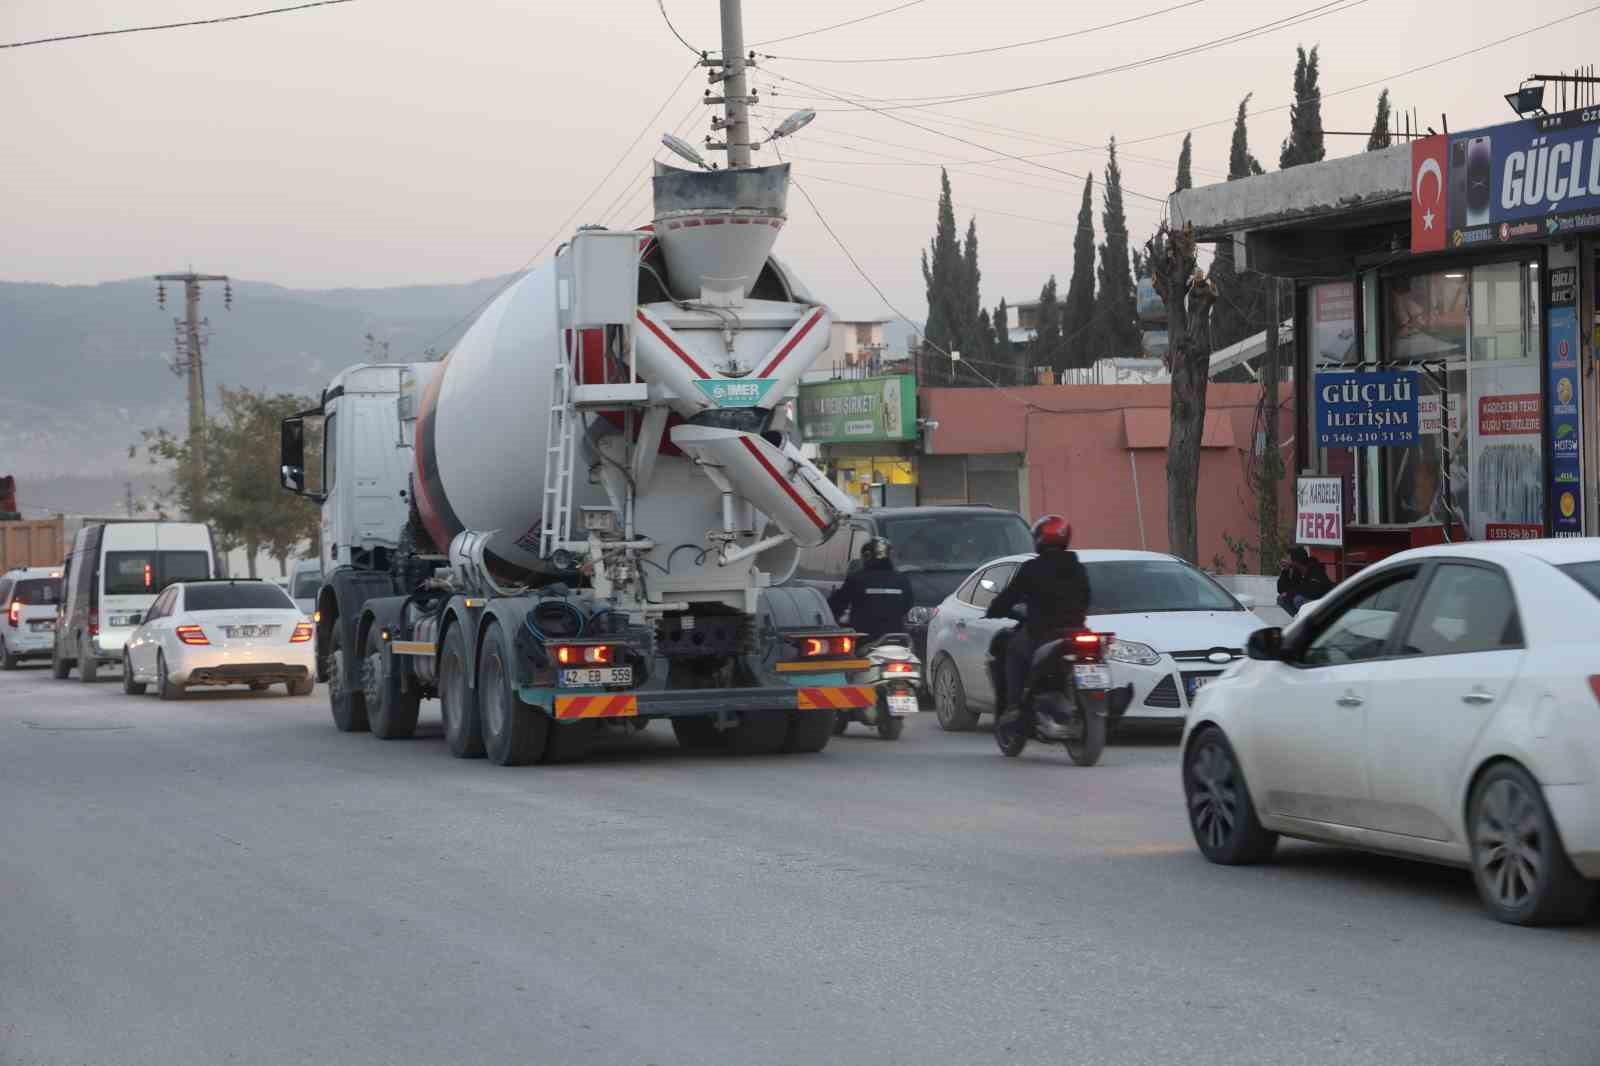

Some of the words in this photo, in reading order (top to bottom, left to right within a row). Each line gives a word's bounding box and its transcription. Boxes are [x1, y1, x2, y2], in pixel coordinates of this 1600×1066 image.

[1322, 378, 1411, 408] GÜÇLÜ
[1327, 408, 1408, 429] İLETİŞİM
[1310, 483, 1340, 504] KARDELEN
[566, 671, 578, 682] 42
